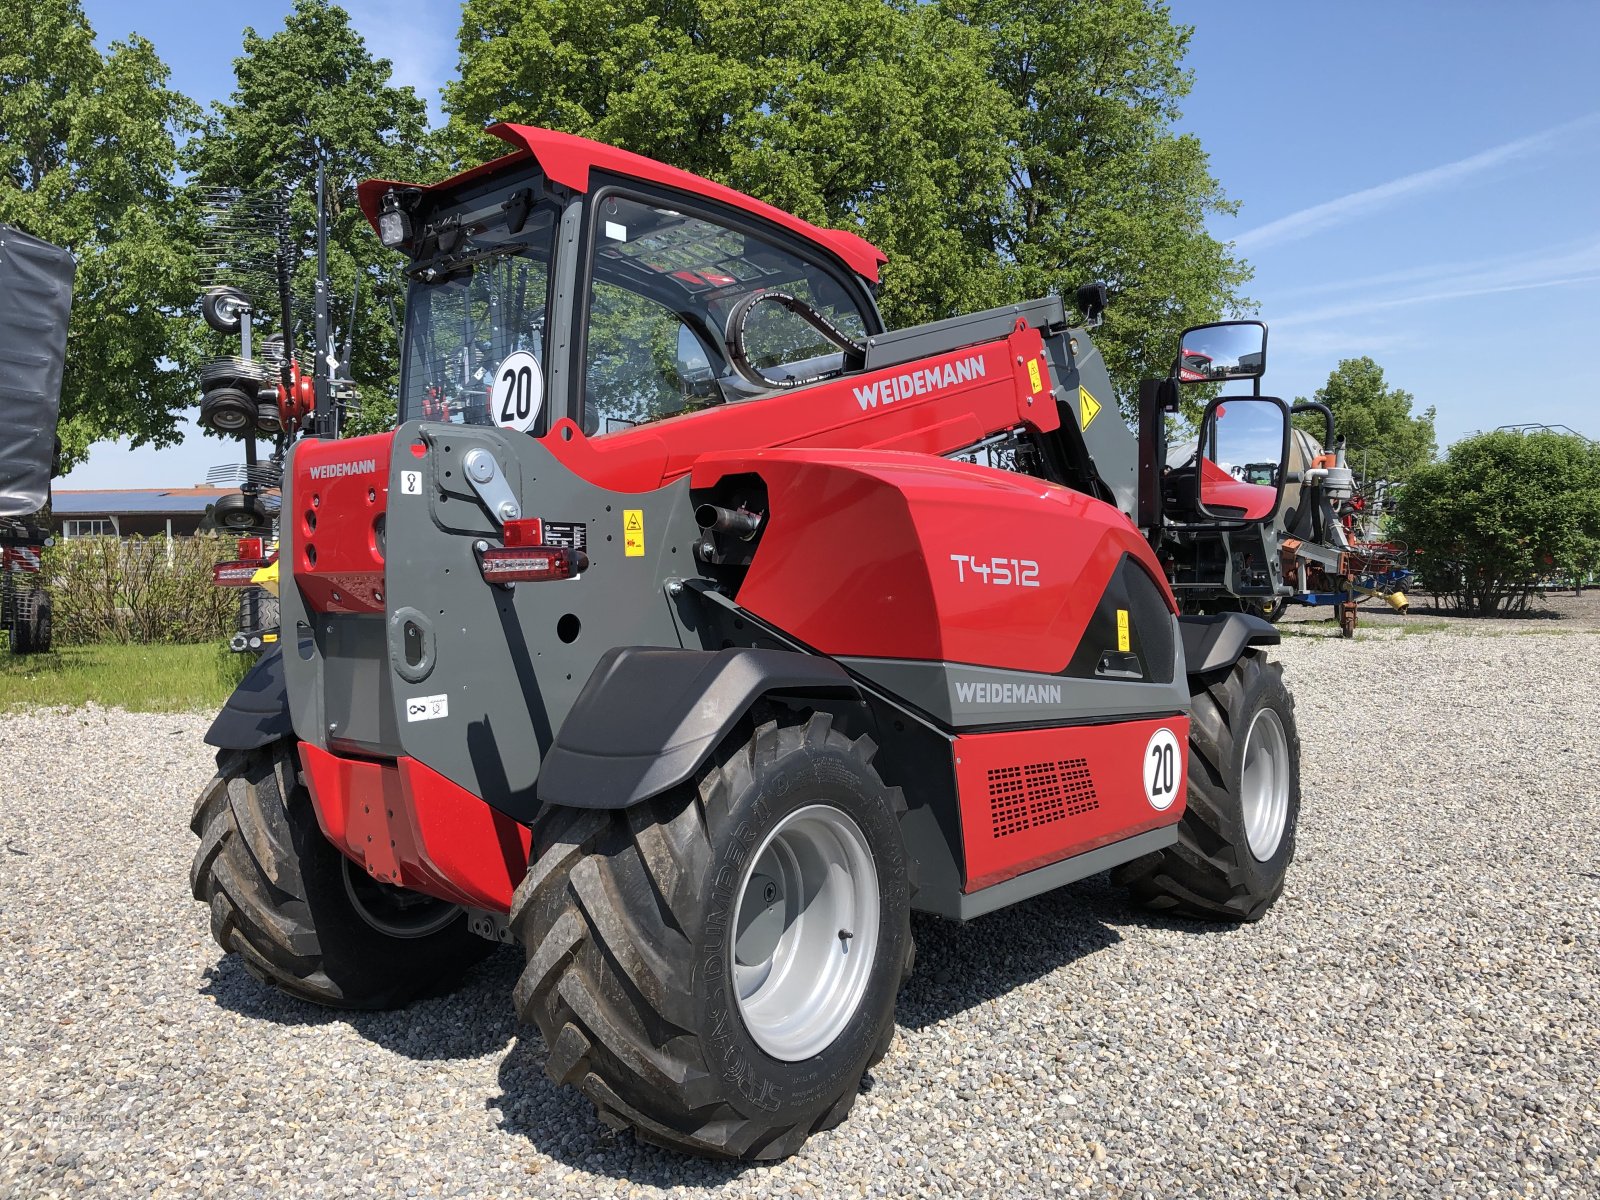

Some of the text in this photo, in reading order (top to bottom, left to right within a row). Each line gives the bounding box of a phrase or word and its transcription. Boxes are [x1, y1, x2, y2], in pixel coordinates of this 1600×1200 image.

[501, 366, 532, 422] 20
[853, 355, 986, 411] WEIDEMANN
[310, 459, 376, 480] WEIDEMANN
[950, 554, 1040, 588] T4512
[955, 681, 1062, 705] WEIDEMANN
[1152, 743, 1174, 796] 20
[703, 820, 758, 982] DUMPER
